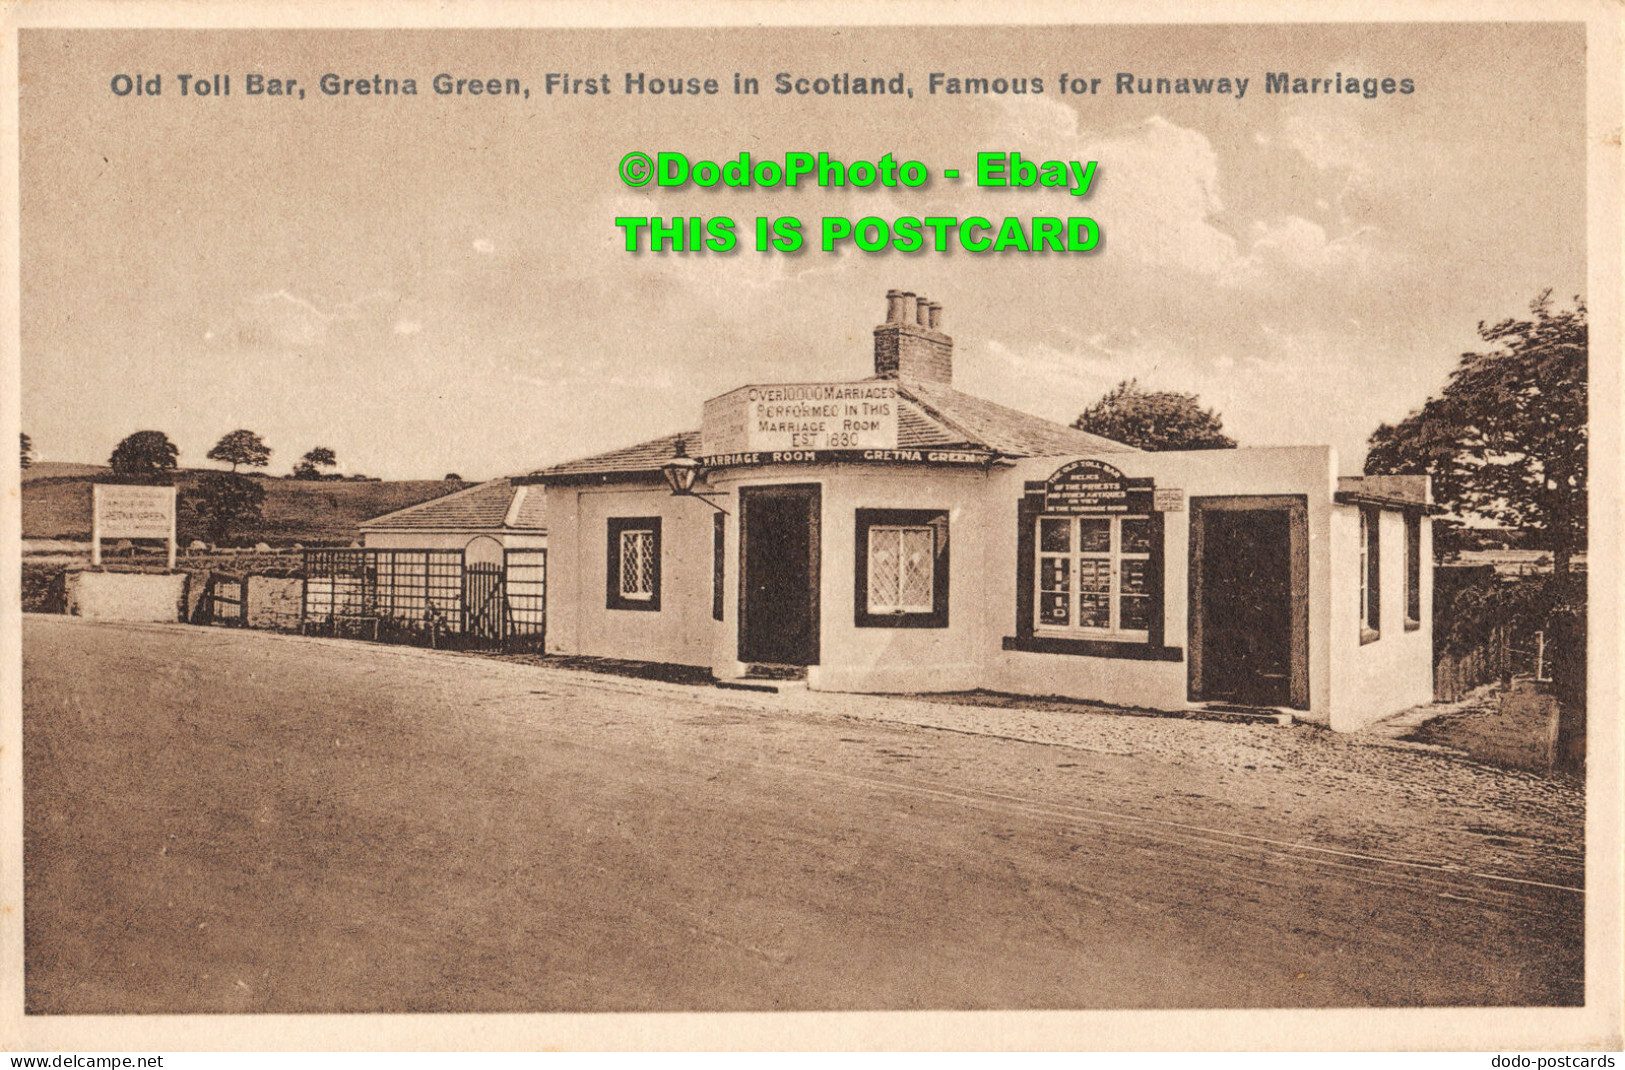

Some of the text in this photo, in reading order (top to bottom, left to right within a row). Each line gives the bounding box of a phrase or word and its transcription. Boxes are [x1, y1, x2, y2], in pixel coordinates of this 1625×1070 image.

[844, 404, 858, 416] IN
[862, 402, 891, 416] THIS
[758, 419, 880, 432] MARRIAGE ROOM
[826, 432, 859, 447] 1830
[703, 450, 816, 467] MARRIAGE ROOM
[863, 450, 975, 463] GRETNA GREEN
[1080, 461, 1102, 469] TOLL
